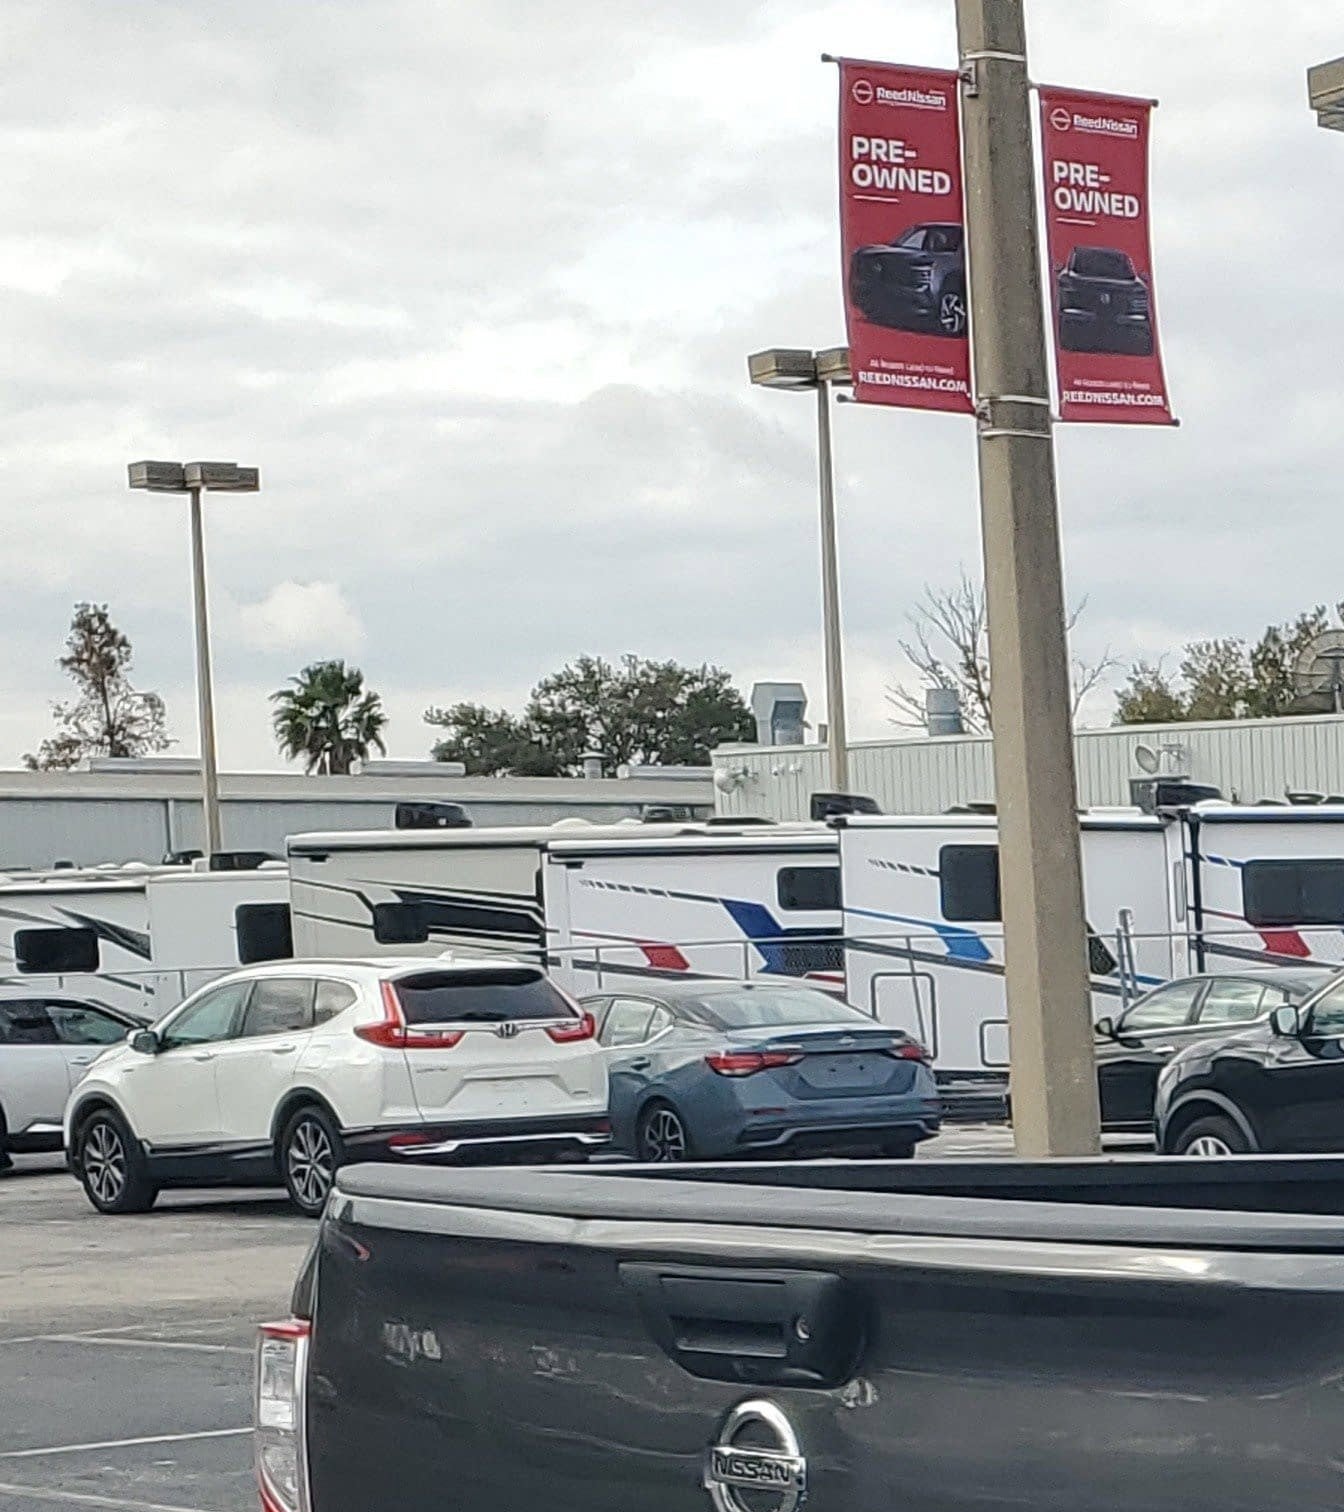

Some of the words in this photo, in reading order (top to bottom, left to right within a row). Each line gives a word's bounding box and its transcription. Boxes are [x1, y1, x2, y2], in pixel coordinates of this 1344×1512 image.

[852, 136, 917, 163] PRE-
[852, 164, 951, 195] OWNED
[1053, 161, 1111, 188] PRE-
[1054, 187, 1140, 218] OWNED
[859, 371, 967, 393] REEDNISSAN.COM
[713, 1451, 791, 1484] NISSAN
